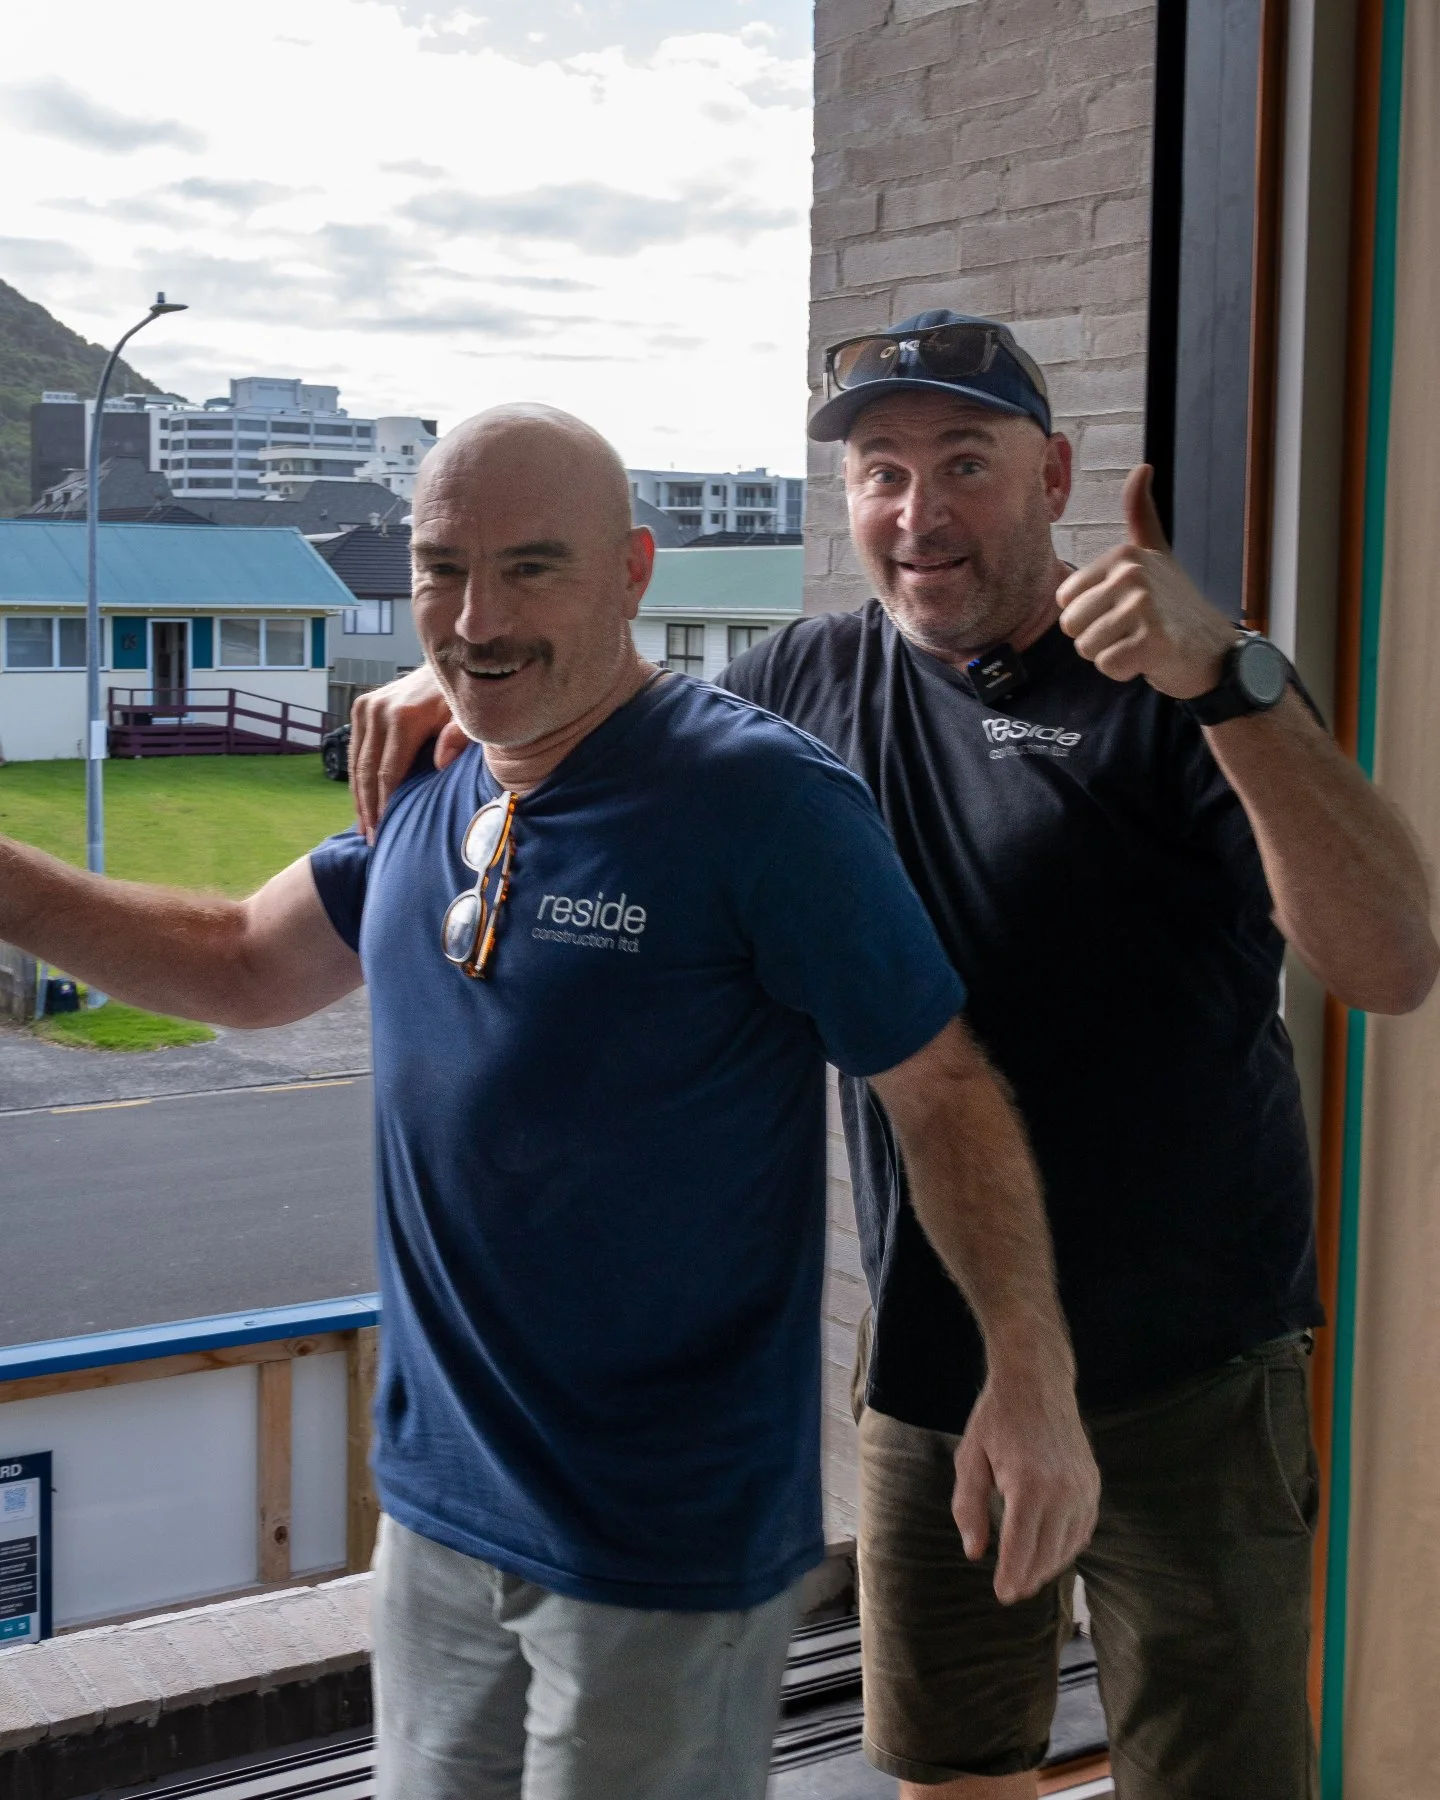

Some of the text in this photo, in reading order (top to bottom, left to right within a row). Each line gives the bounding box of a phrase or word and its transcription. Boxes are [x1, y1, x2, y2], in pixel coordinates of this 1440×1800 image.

[982, 718, 1082, 746] reside
[536, 891, 647, 934] reside
[531, 927, 615, 949] construction
